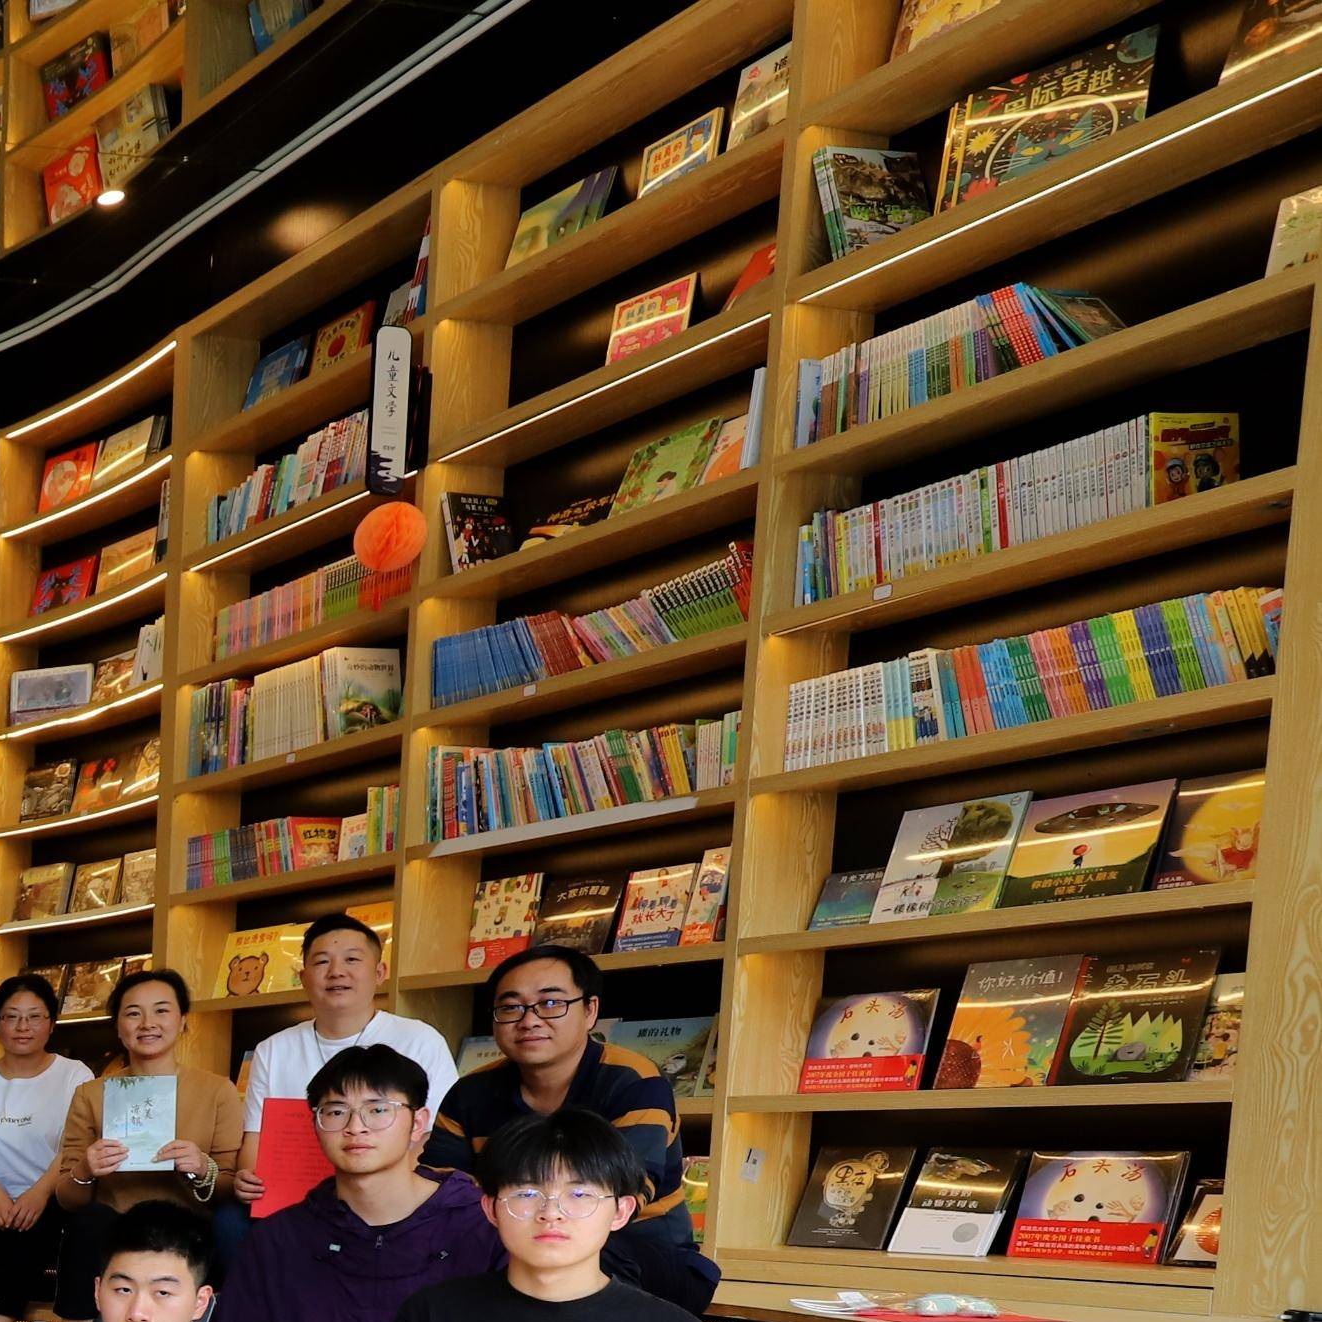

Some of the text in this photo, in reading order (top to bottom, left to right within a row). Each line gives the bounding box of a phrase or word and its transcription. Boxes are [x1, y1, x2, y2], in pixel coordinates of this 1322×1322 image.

[386, 348, 401, 418] 儿童文学
[921, 1199, 979, 1210] 动物字母表
